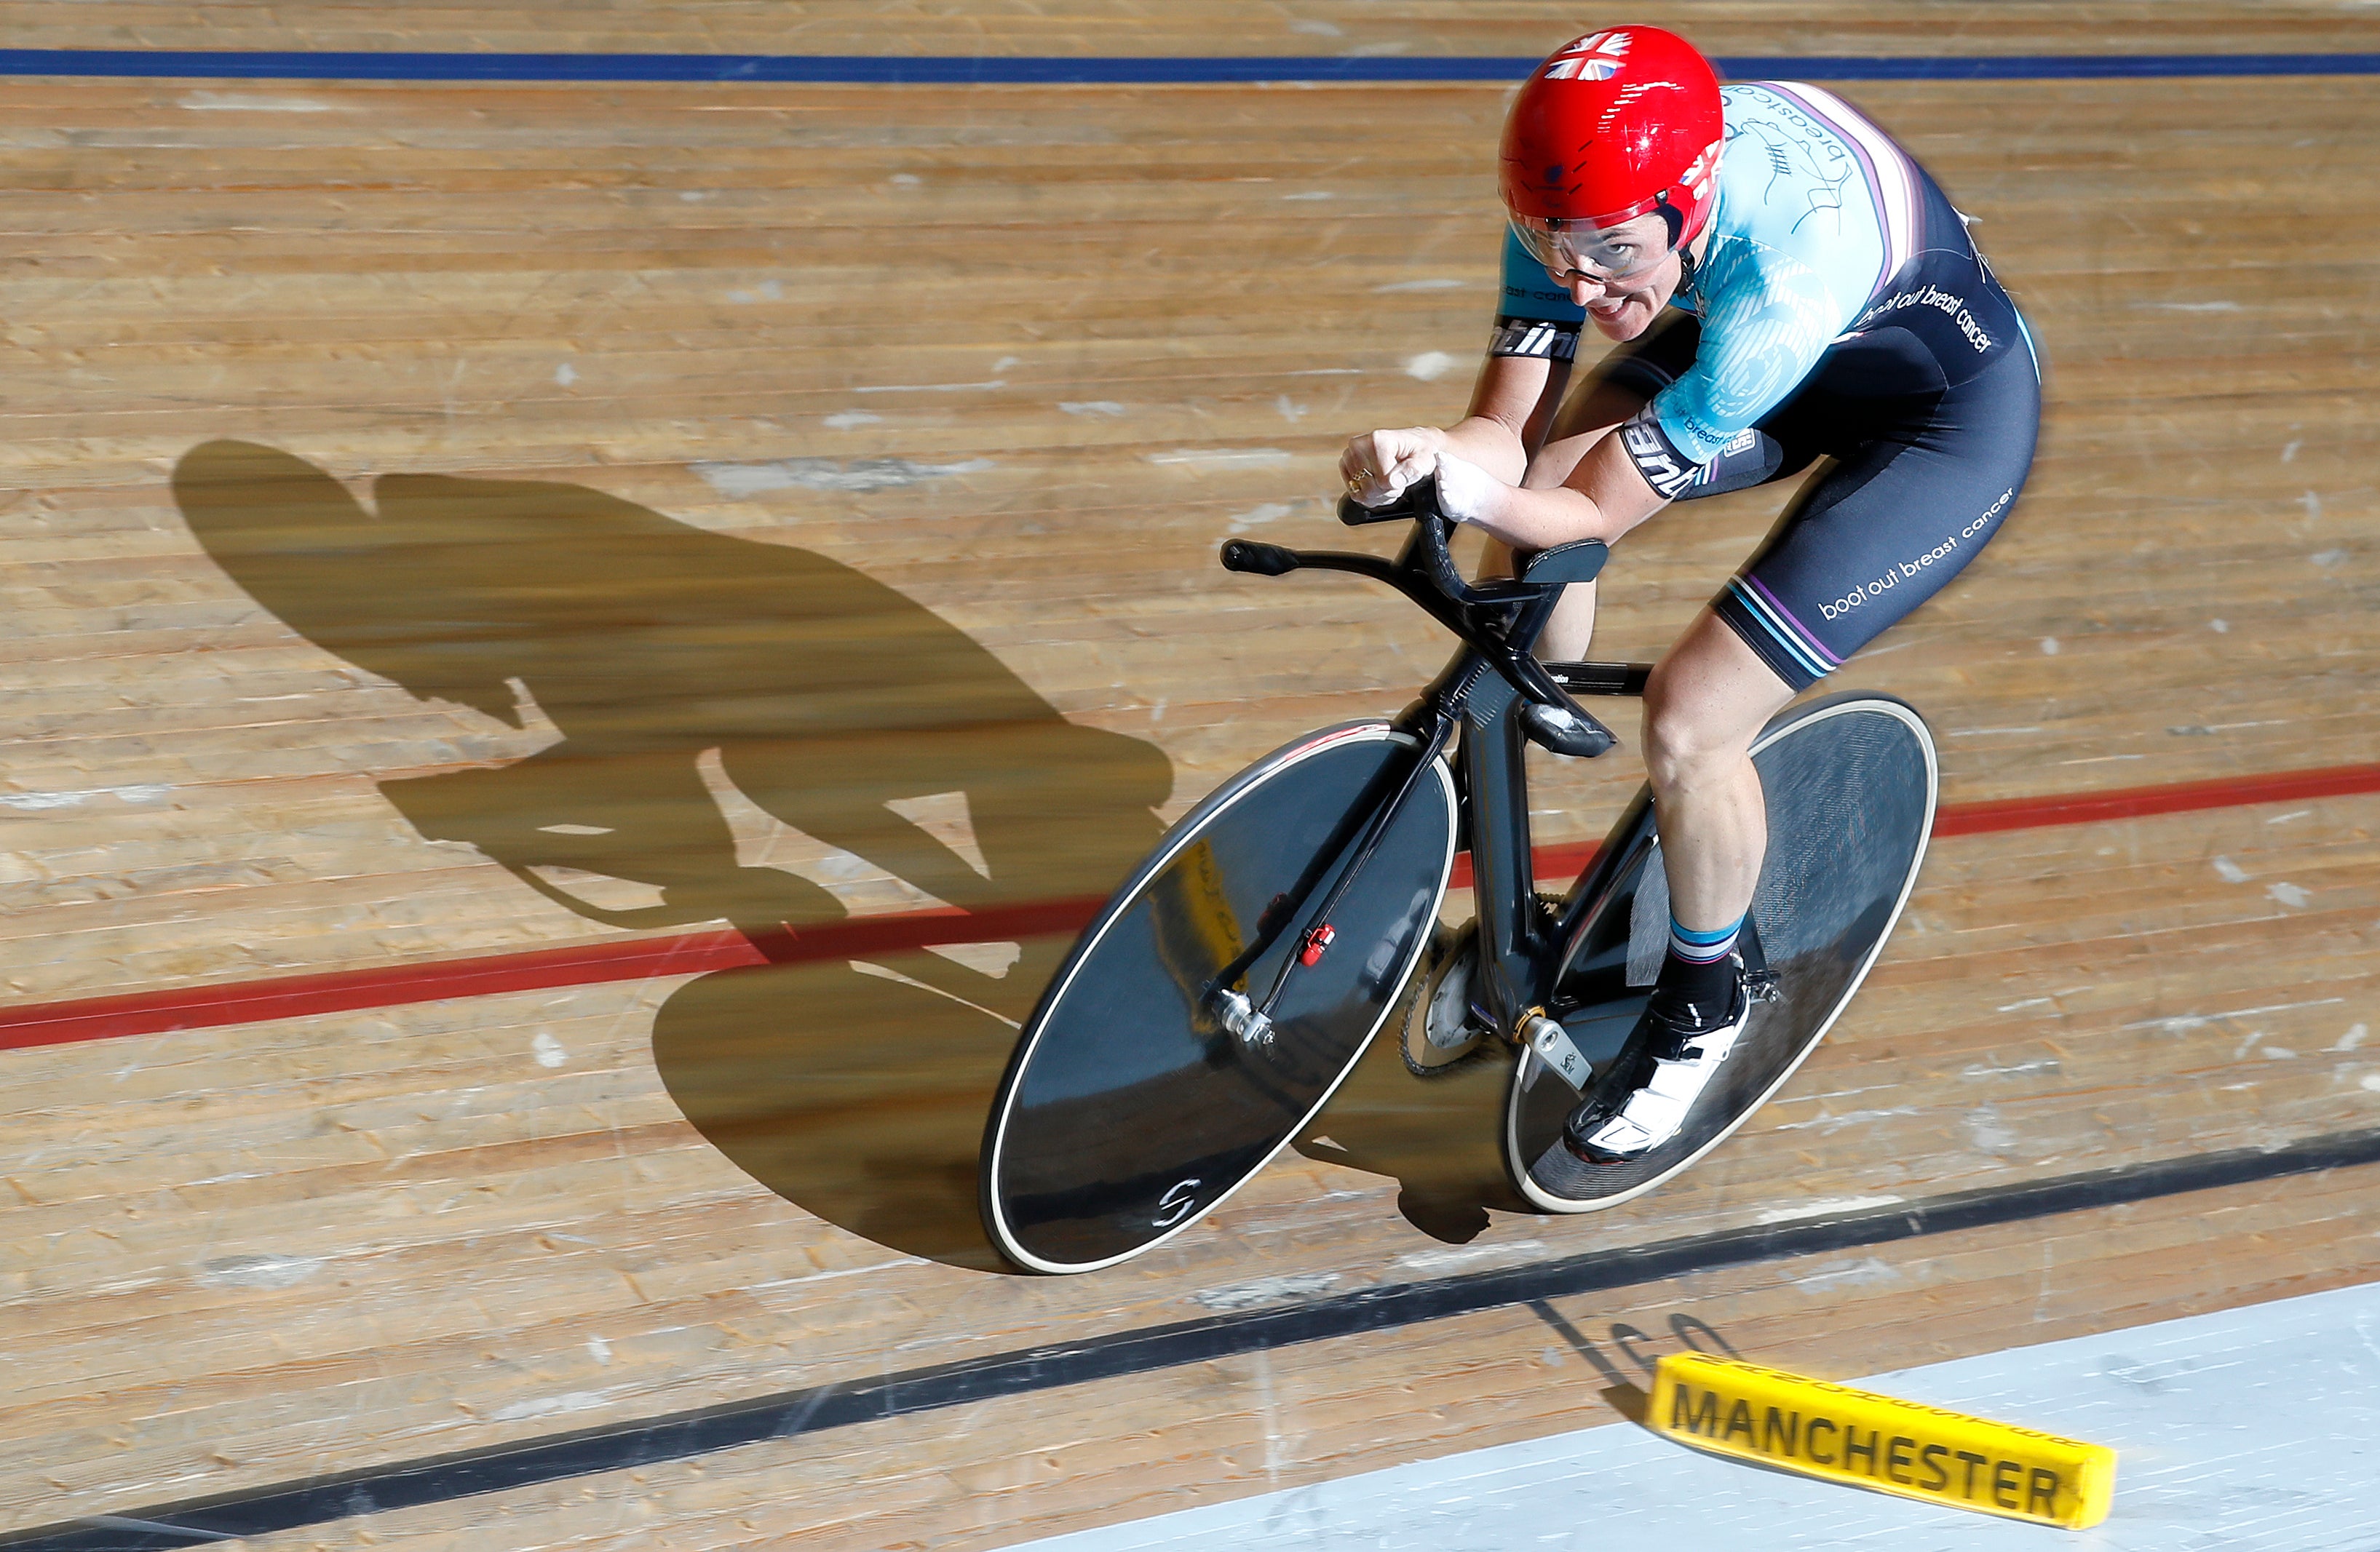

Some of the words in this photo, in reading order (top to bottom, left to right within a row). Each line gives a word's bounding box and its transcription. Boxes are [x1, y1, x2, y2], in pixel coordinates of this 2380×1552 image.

[1897, 284, 1927, 309] out
[1921, 284, 1963, 316] breast
[1956, 309, 1992, 354] cancer
[1683, 415, 1724, 445] breast
[1818, 584, 1868, 621] boot
[1868, 568, 1900, 595] out
[1898, 536, 1958, 578] breast
[1961, 487, 2014, 539] cancer
[1671, 1383, 2056, 1519] MANCHESTER
